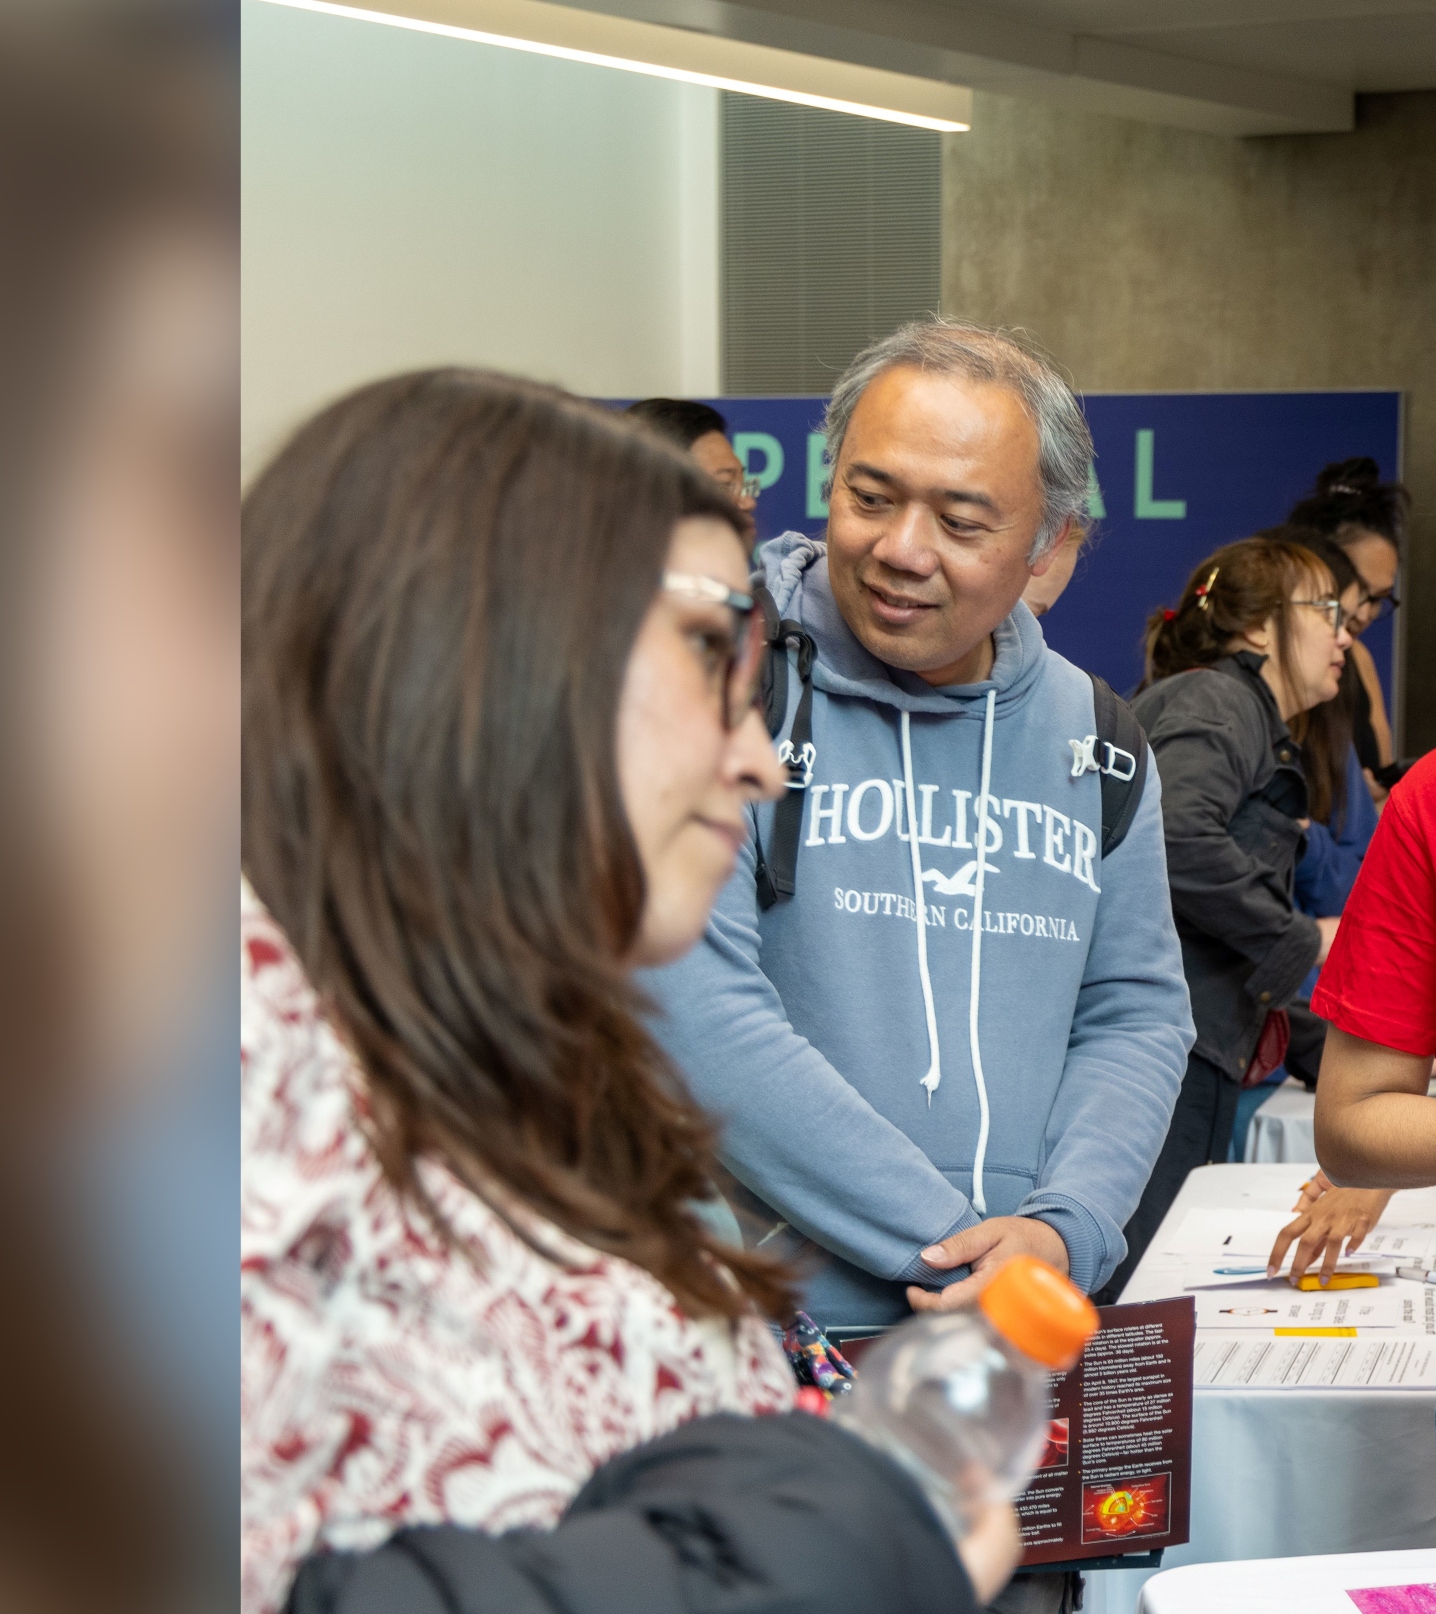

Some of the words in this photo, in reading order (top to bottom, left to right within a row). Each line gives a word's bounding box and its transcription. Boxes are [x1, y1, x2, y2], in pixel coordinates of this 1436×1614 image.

[805, 778, 1101, 893] HOLLISTER
[954, 907, 1080, 942] CLIFORNIA
[1425, 1297, 1436, 1307] would
